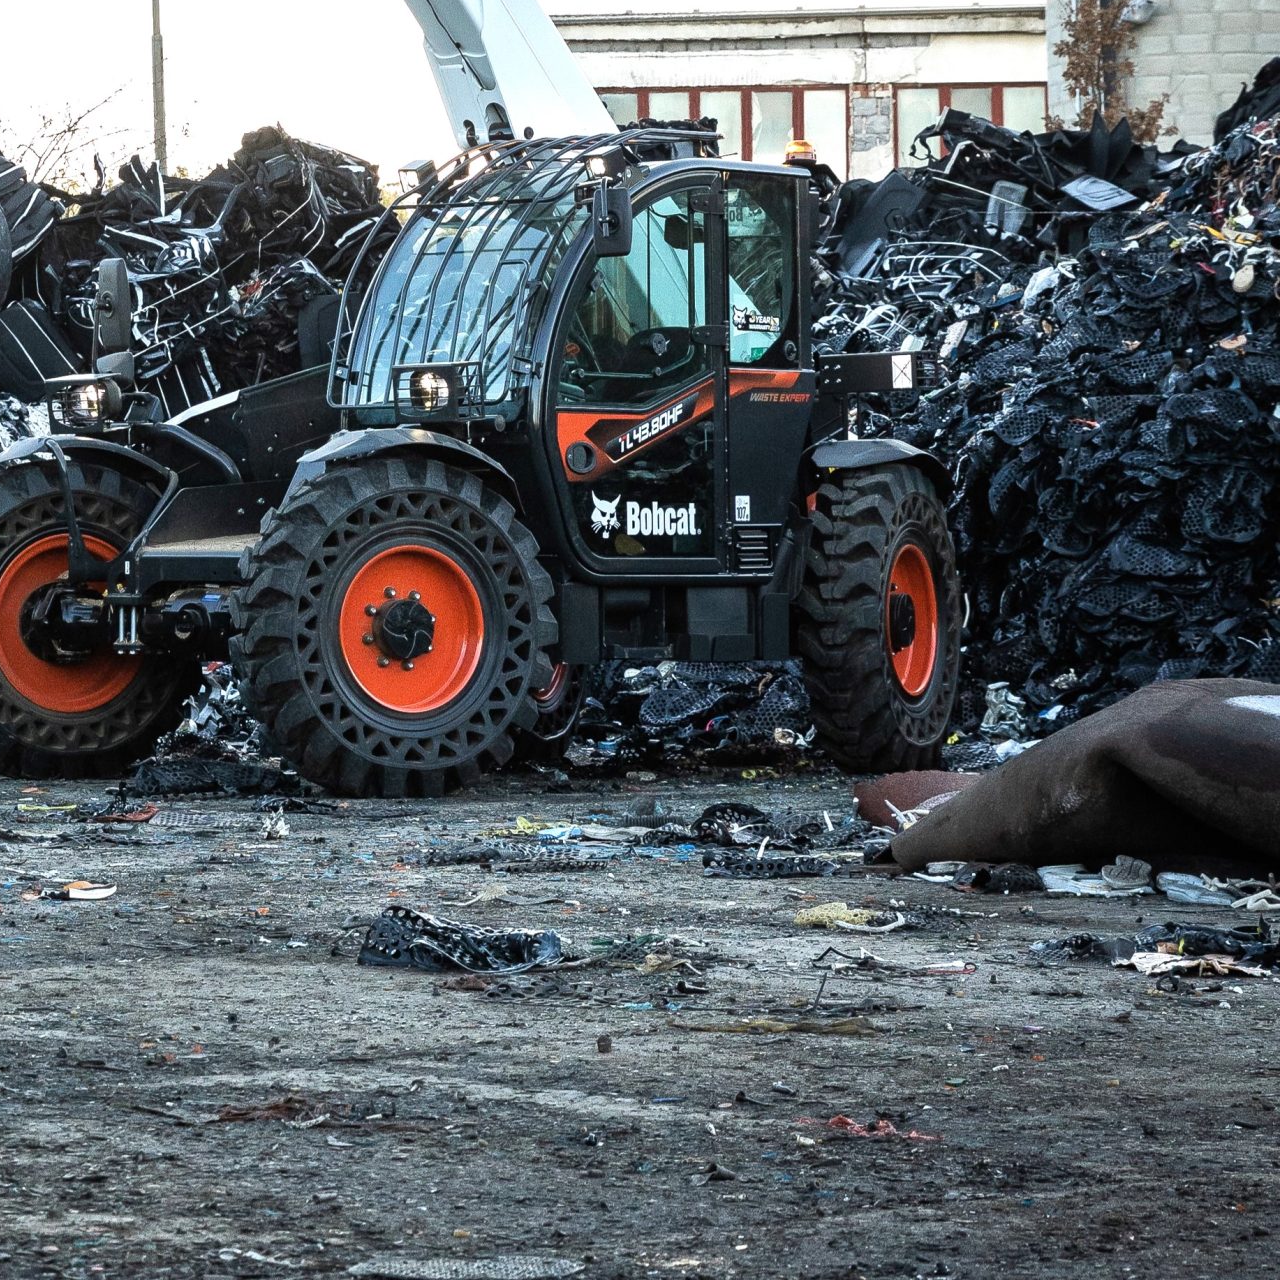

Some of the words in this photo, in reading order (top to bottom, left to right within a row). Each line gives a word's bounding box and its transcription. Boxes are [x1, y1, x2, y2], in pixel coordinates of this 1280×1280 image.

[755, 315, 771, 325] YEAR
[749, 392, 779, 402] WASTE
[779, 392, 811, 402] EXPERT
[626, 501, 697, 536] Bobcat
[736, 506, 747, 520] 107
